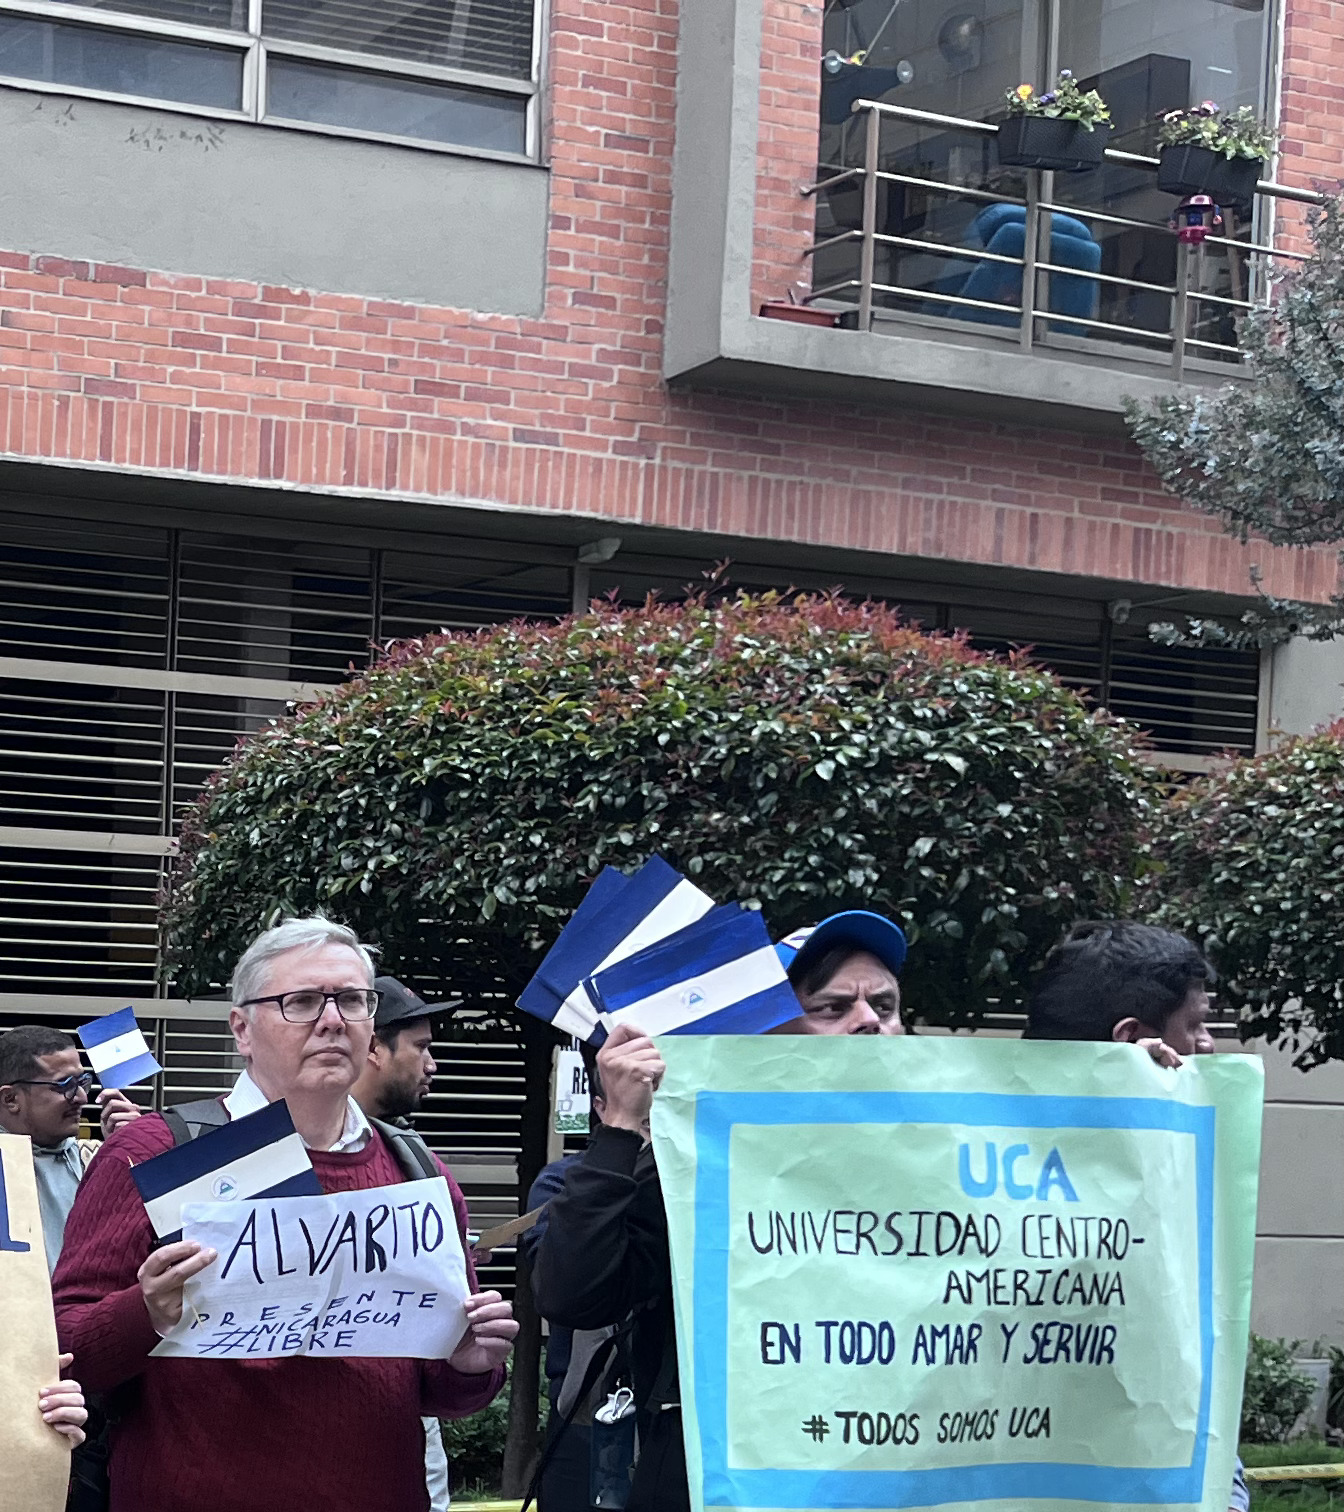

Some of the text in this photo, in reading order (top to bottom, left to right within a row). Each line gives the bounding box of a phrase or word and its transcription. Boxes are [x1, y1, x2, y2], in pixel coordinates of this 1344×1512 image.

[958, 1142, 1080, 1202] UCA
[221, 1201, 444, 1284] ALVARITO
[748, 1210, 1145, 1261] UNIVERSIDAD CENTRO-
[191, 1290, 437, 1330] PRESENTE
[942, 1269, 1126, 1306] AMERICANA
[760, 1321, 1118, 1366] EN TODO AMAR Y SERVIR
[936, 1408, 996, 1441] SOMOS
[1008, 1407, 1052, 1439] UCA
